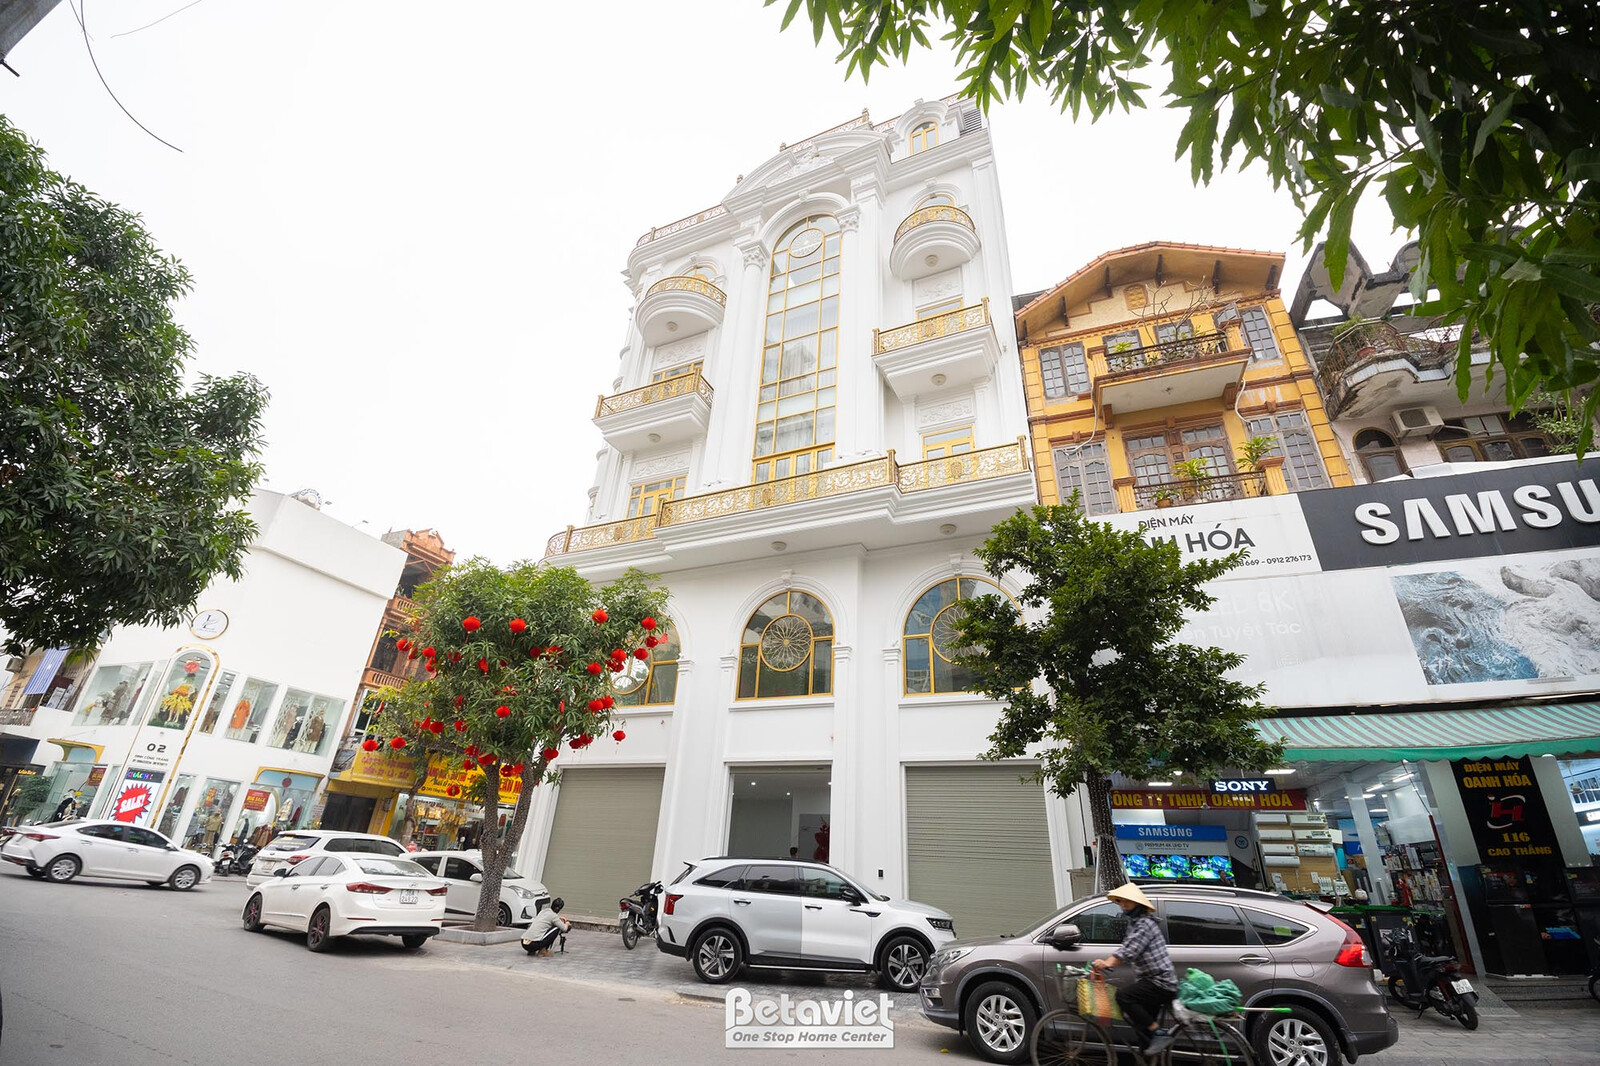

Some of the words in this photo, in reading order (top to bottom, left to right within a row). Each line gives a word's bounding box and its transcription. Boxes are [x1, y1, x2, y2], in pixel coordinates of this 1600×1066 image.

[1354, 479, 1600, 545] SAMSU
[1169, 514, 1194, 527] MÁY
[1184, 523, 1256, 553] HÓA
[146, 743, 167, 753] 02
[1463, 762, 1492, 773] ĐIỆN
[1494, 761, 1520, 771] MÁY
[1215, 780, 1269, 792] SONY
[1463, 776, 1501, 788] OANH
[1112, 791, 1143, 806] ÔNG
[1149, 793, 1163, 807] TY
[1167, 793, 1207, 807] TNHH
[1212, 793, 1255, 807] OANH
[1138, 827, 1193, 837] SAMSUNG
[1502, 832, 1531, 843] 116
[1488, 848, 1511, 856] CAO
